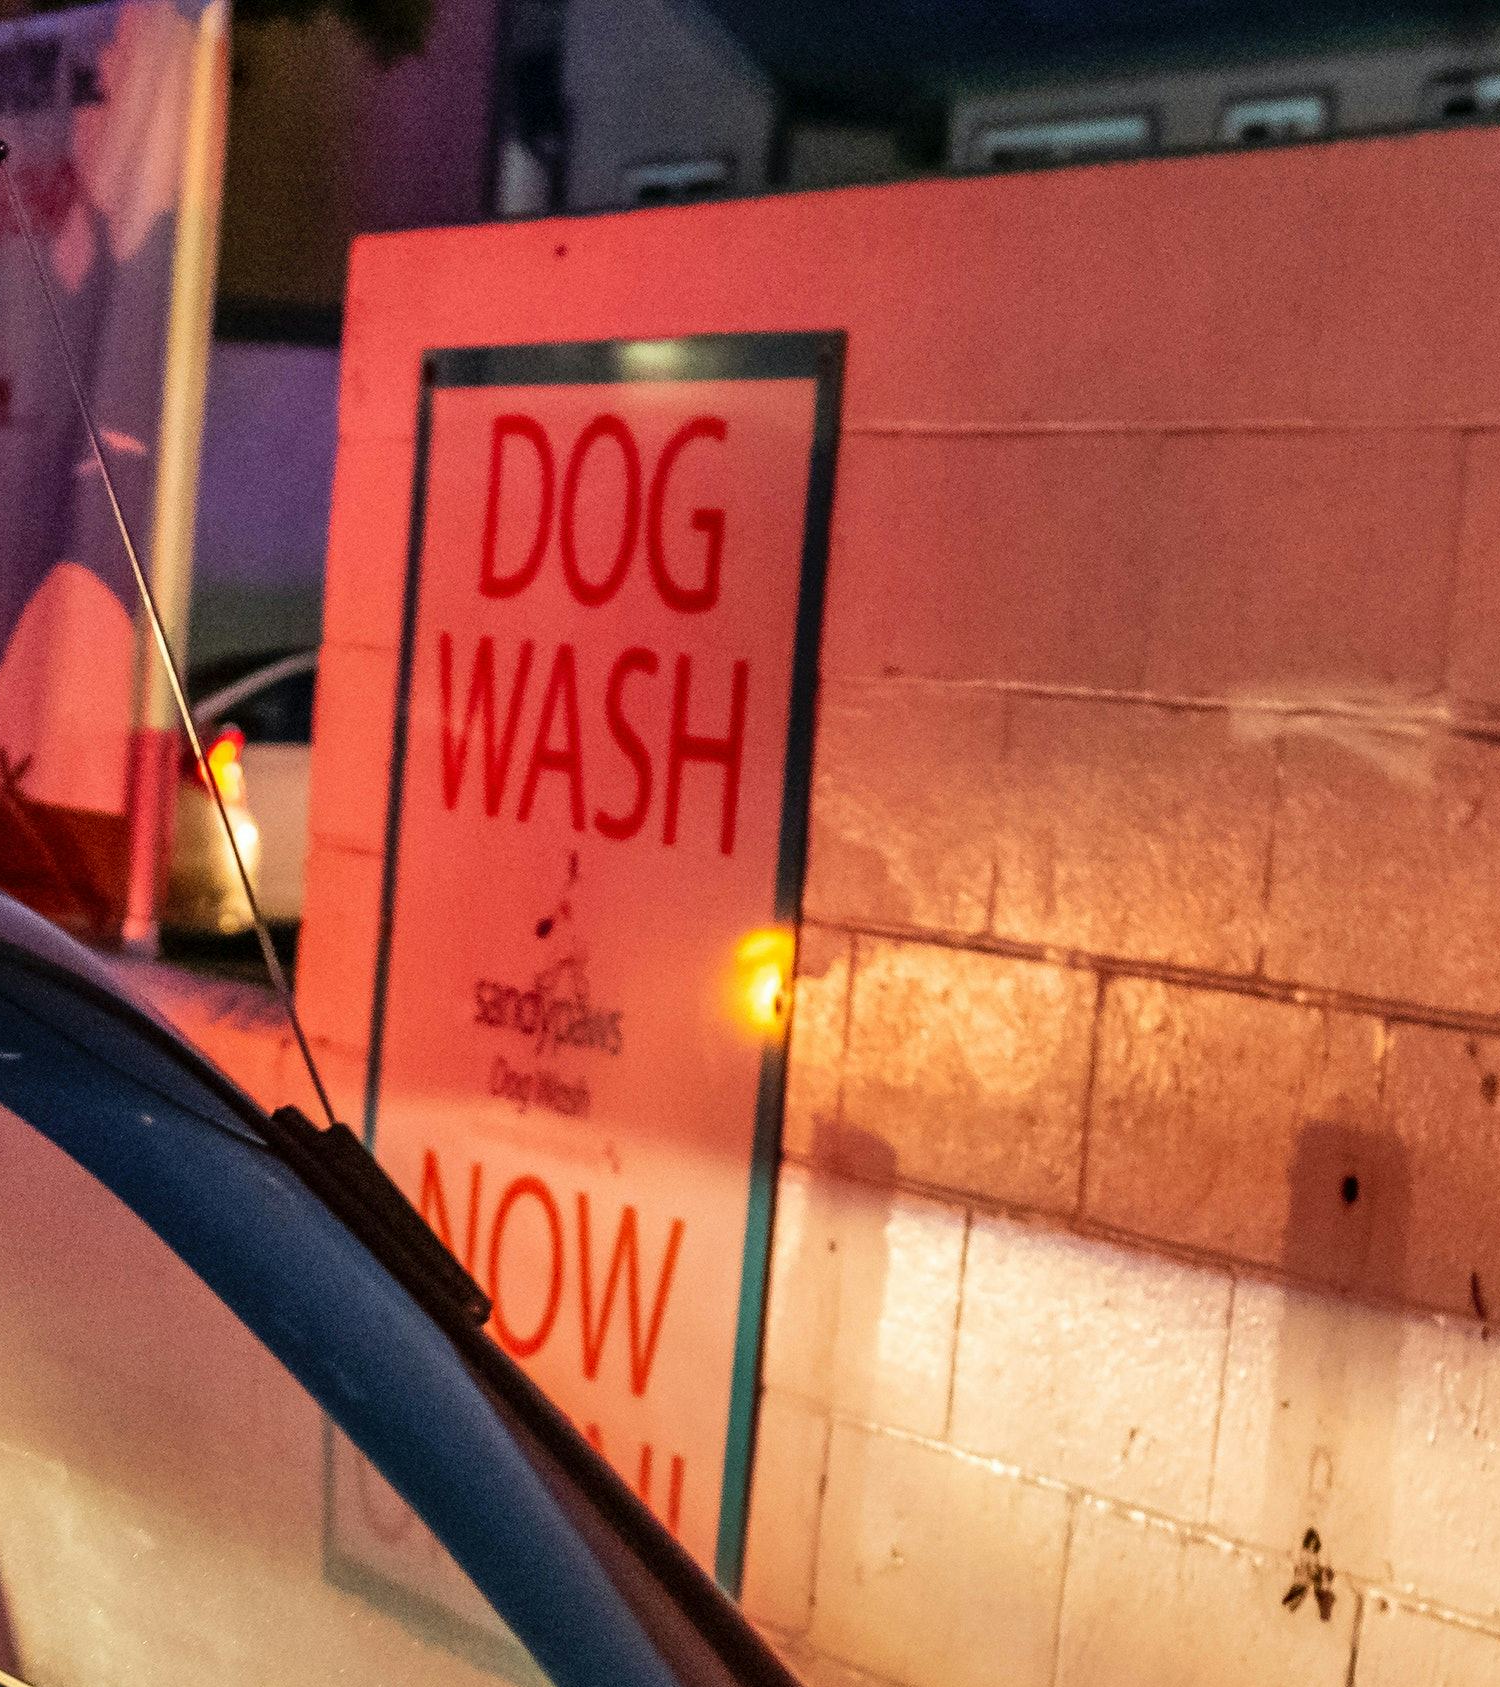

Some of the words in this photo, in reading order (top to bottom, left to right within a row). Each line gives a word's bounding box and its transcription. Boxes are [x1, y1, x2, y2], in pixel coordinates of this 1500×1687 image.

[478, 412, 729, 615] DOG
[438, 631, 750, 856] WASH
[473, 977, 625, 1058] sandypaws
[488, 1055, 533, 1116] Dog
[418, 1148, 686, 1399] NOW
